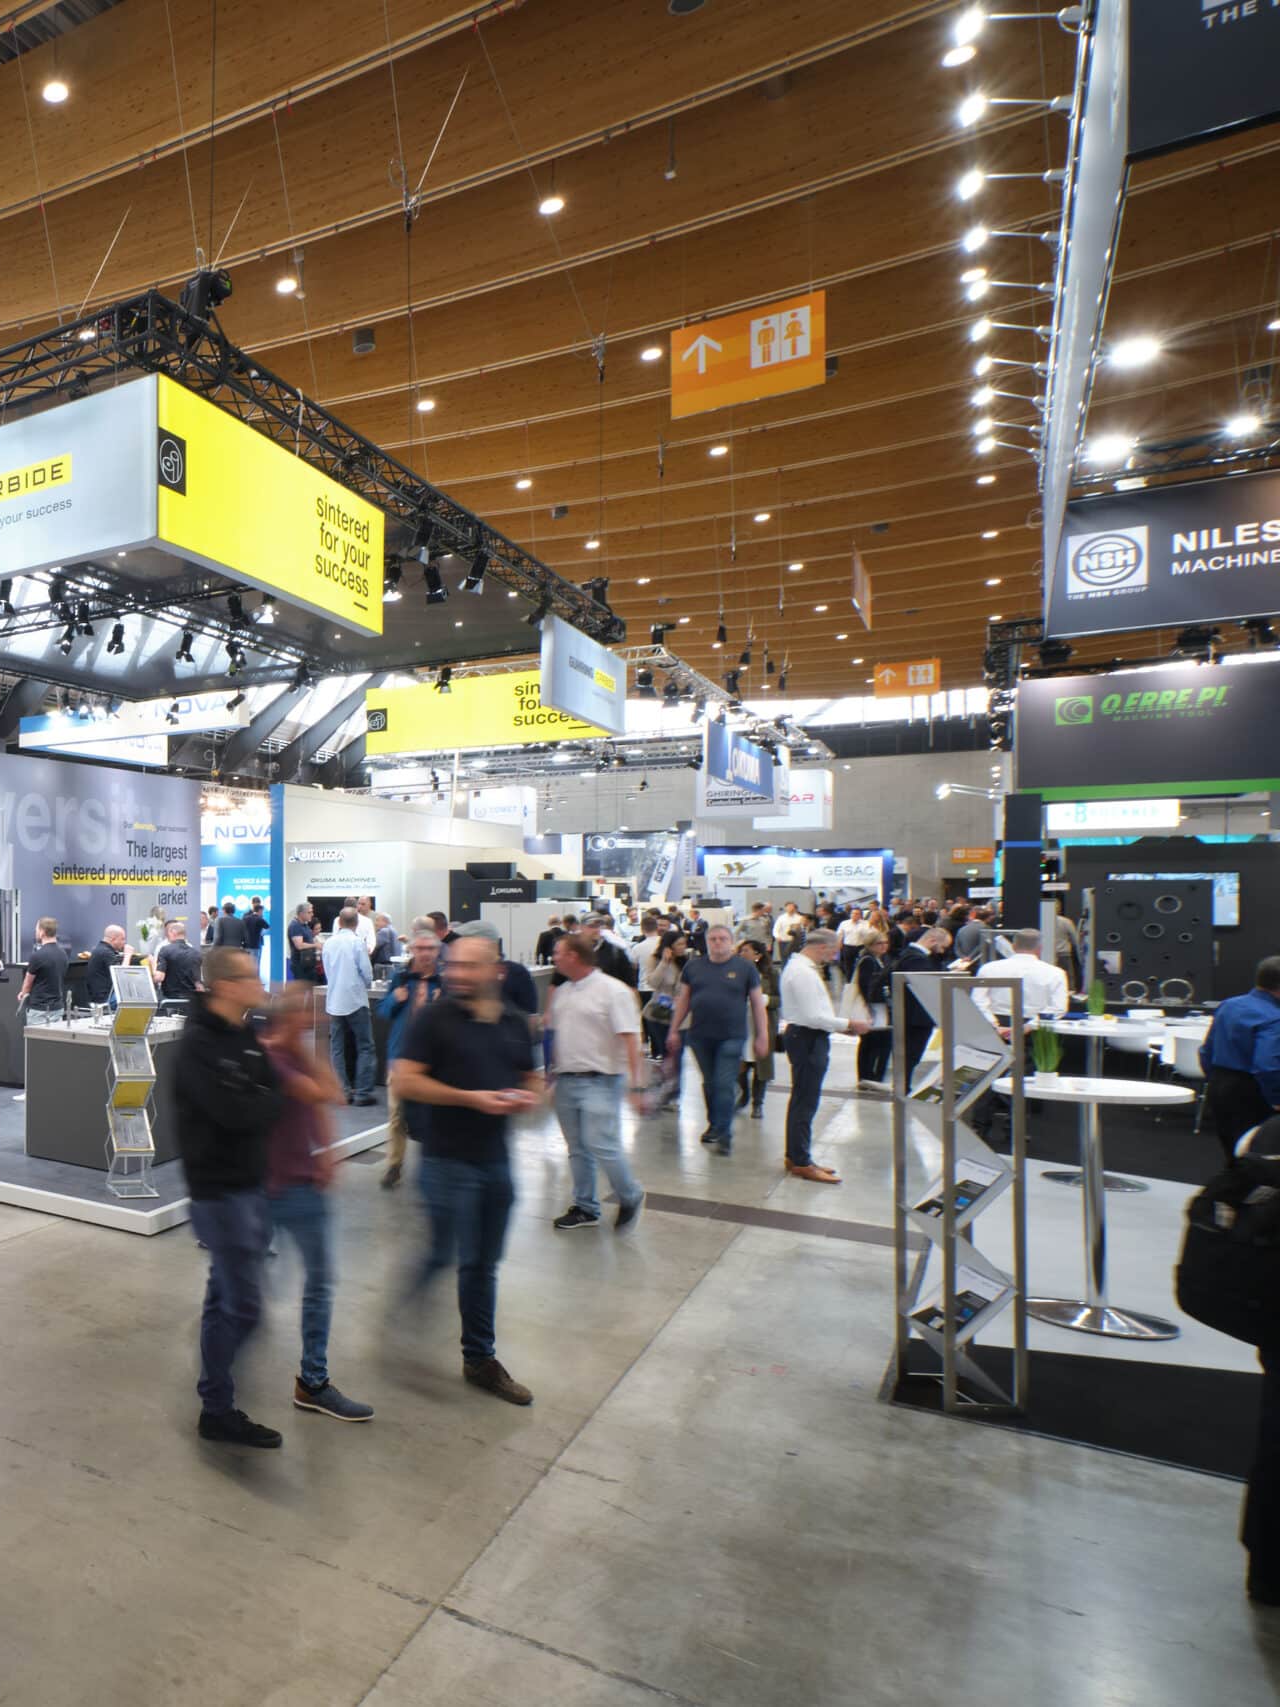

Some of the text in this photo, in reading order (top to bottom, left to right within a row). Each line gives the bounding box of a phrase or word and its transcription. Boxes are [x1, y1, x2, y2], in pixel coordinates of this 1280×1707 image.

[1202, 0, 1258, 28] THE
[0, 511, 23, 529] your
[25, 499, 73, 520] success
[315, 494, 370, 544] sintered
[320, 521, 371, 571] for your
[1172, 519, 1280, 554] NILES
[1078, 548, 1137, 573] NSH
[315, 554, 369, 598] success
[126, 839, 188, 863] The largest
[52, 863, 188, 886] sintered product range
[823, 865, 874, 877] GESAC
[110, 889, 188, 906] on arket
